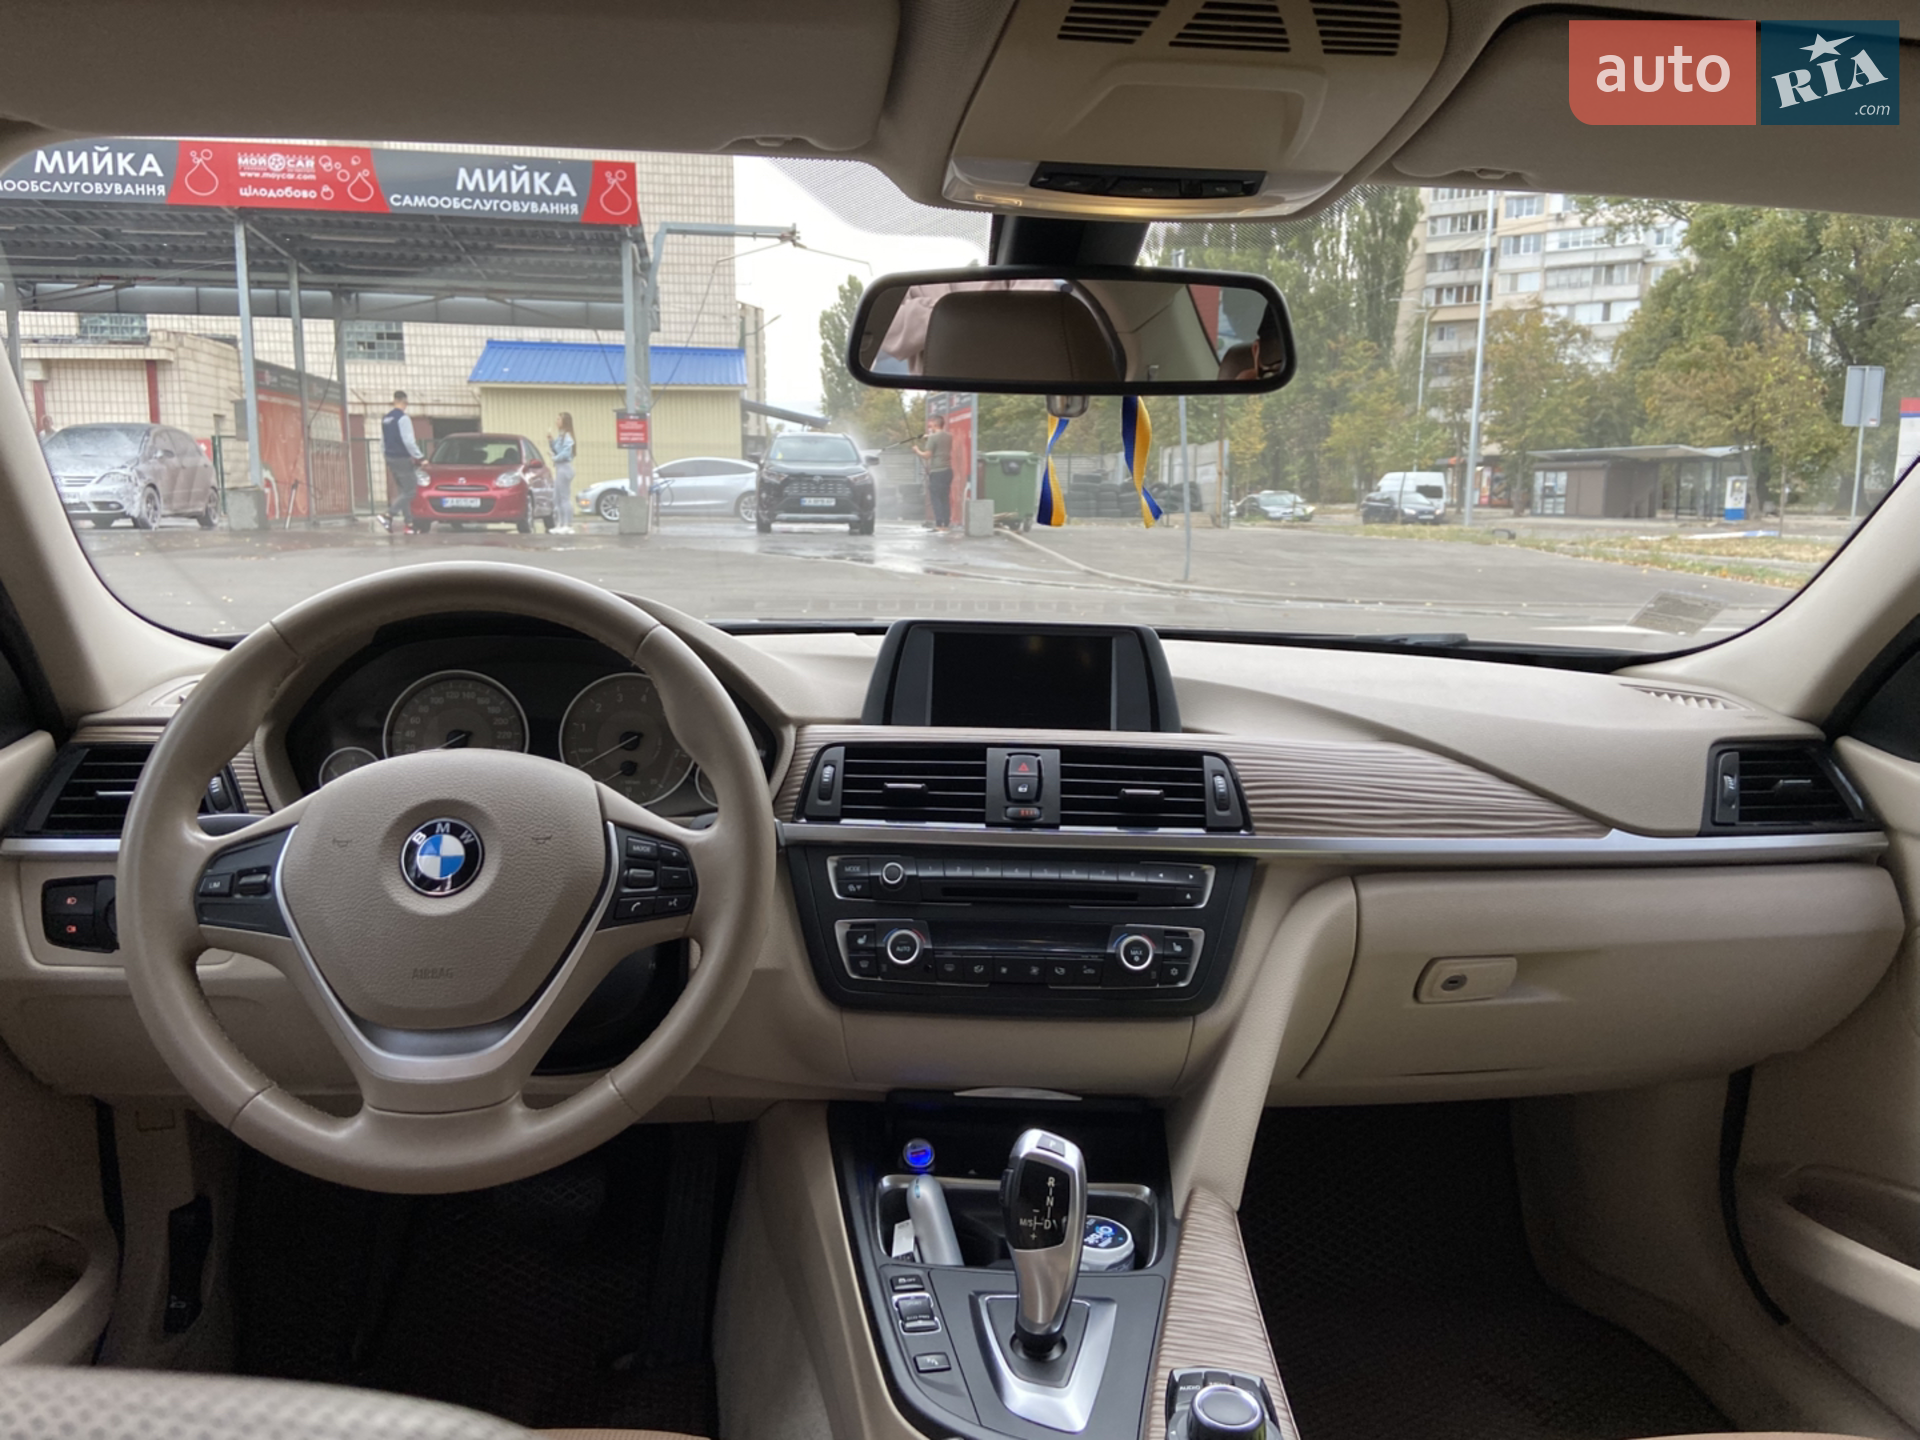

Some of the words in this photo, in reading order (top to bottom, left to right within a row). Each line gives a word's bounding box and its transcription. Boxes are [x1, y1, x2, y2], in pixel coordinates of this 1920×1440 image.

[33, 146, 164, 177] МИЙКА
[0, 179, 166, 196] ООБСЛУГОВУВАННЯ
[455, 164, 578, 197] МИЙКА
[239, 185, 317, 199] цілодобово
[389, 194, 579, 215] САМООБСЛУГОВУВАННЯ
[412, 823, 475, 845] BMW
[1047, 1176, 1055, 1188] R
[1046, 1195, 1054, 1207] N
[1043, 1219, 1052, 1230] D
